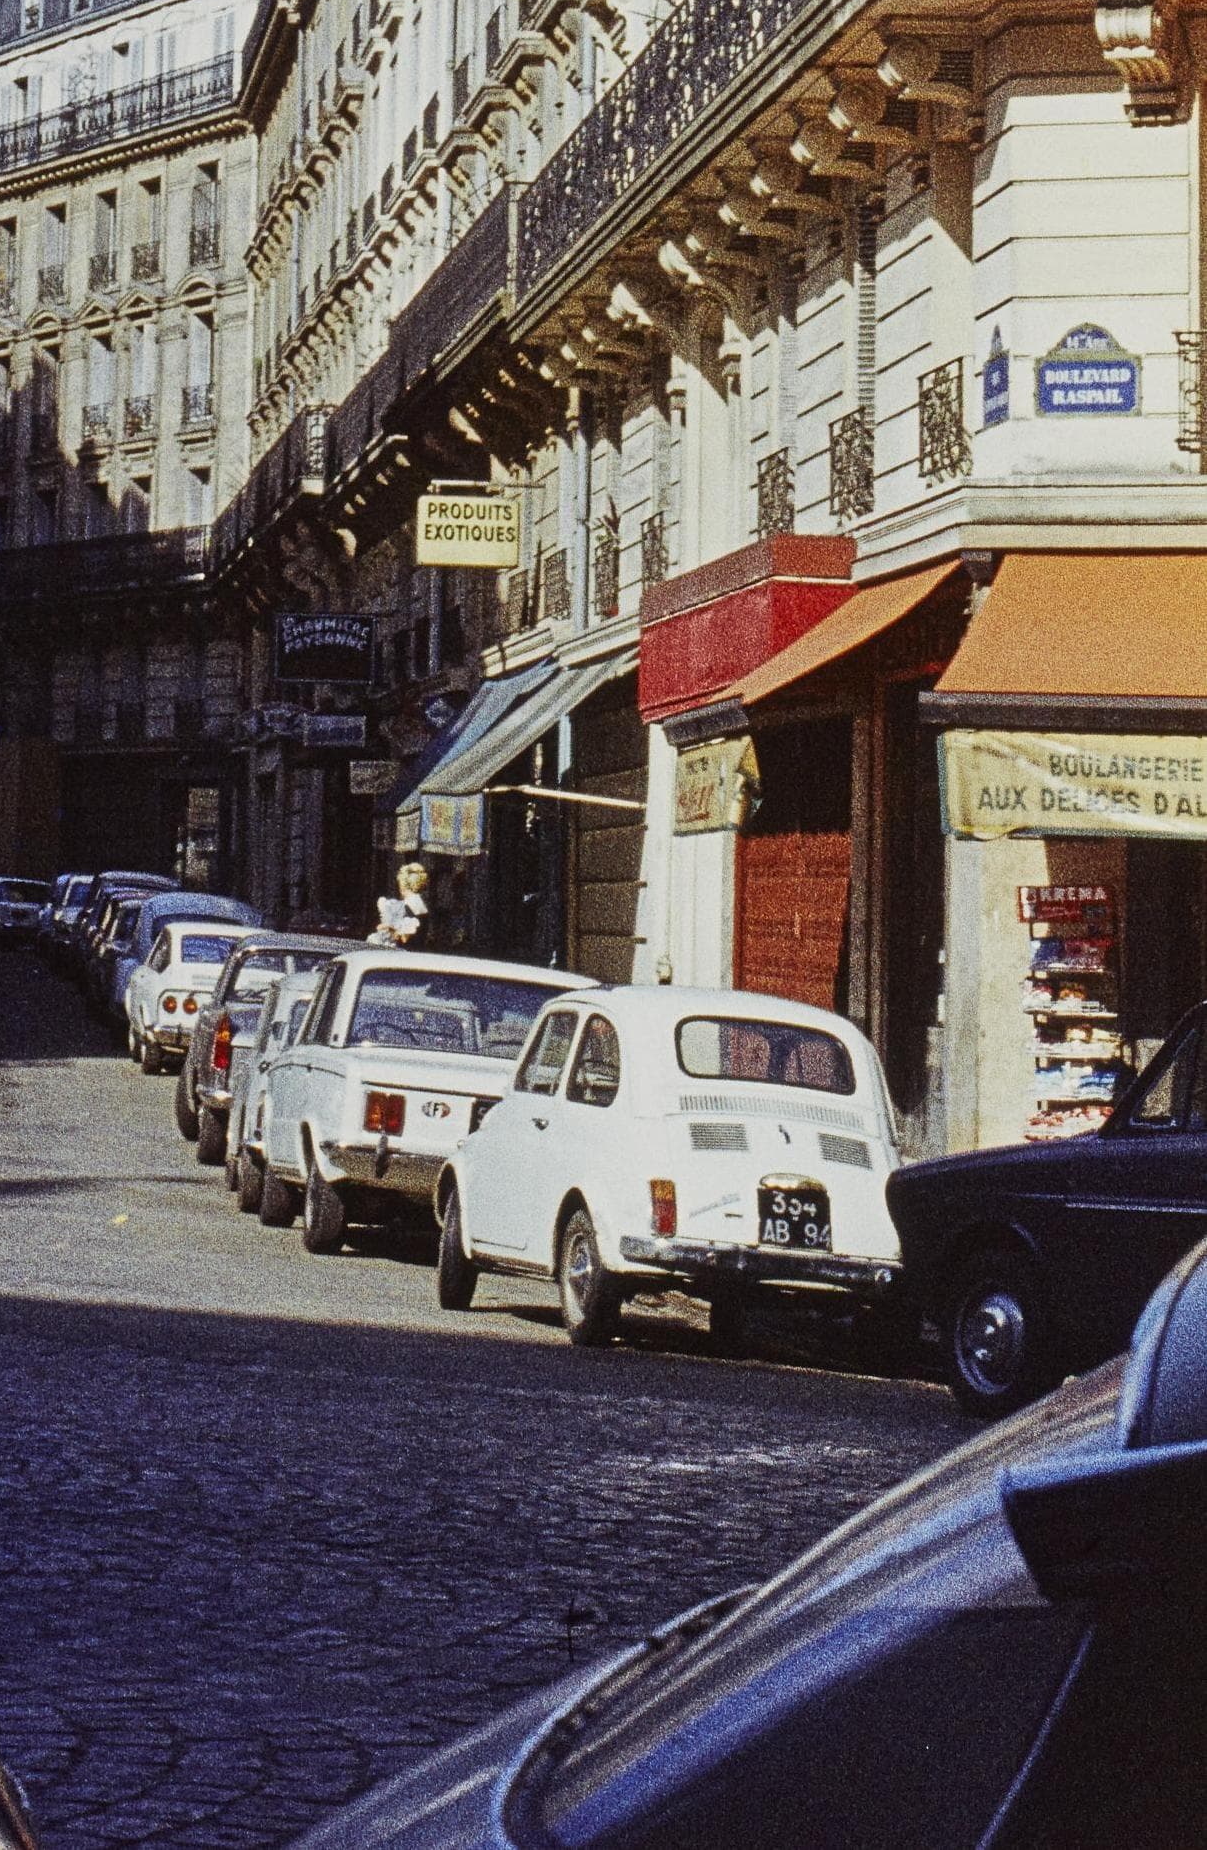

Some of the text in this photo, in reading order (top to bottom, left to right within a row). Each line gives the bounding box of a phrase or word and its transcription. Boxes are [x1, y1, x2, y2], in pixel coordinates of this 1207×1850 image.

[1045, 368, 1132, 384] BOULEVARD
[1052, 388, 1123, 405] RASPAIL
[427, 502, 513, 521] PRODUITS
[425, 524, 516, 542] EXOTIQUES
[1049, 753, 1203, 782] BOULANGERIE
[978, 785, 1028, 811] AUX
[762, 1218, 831, 1248] AB 94
